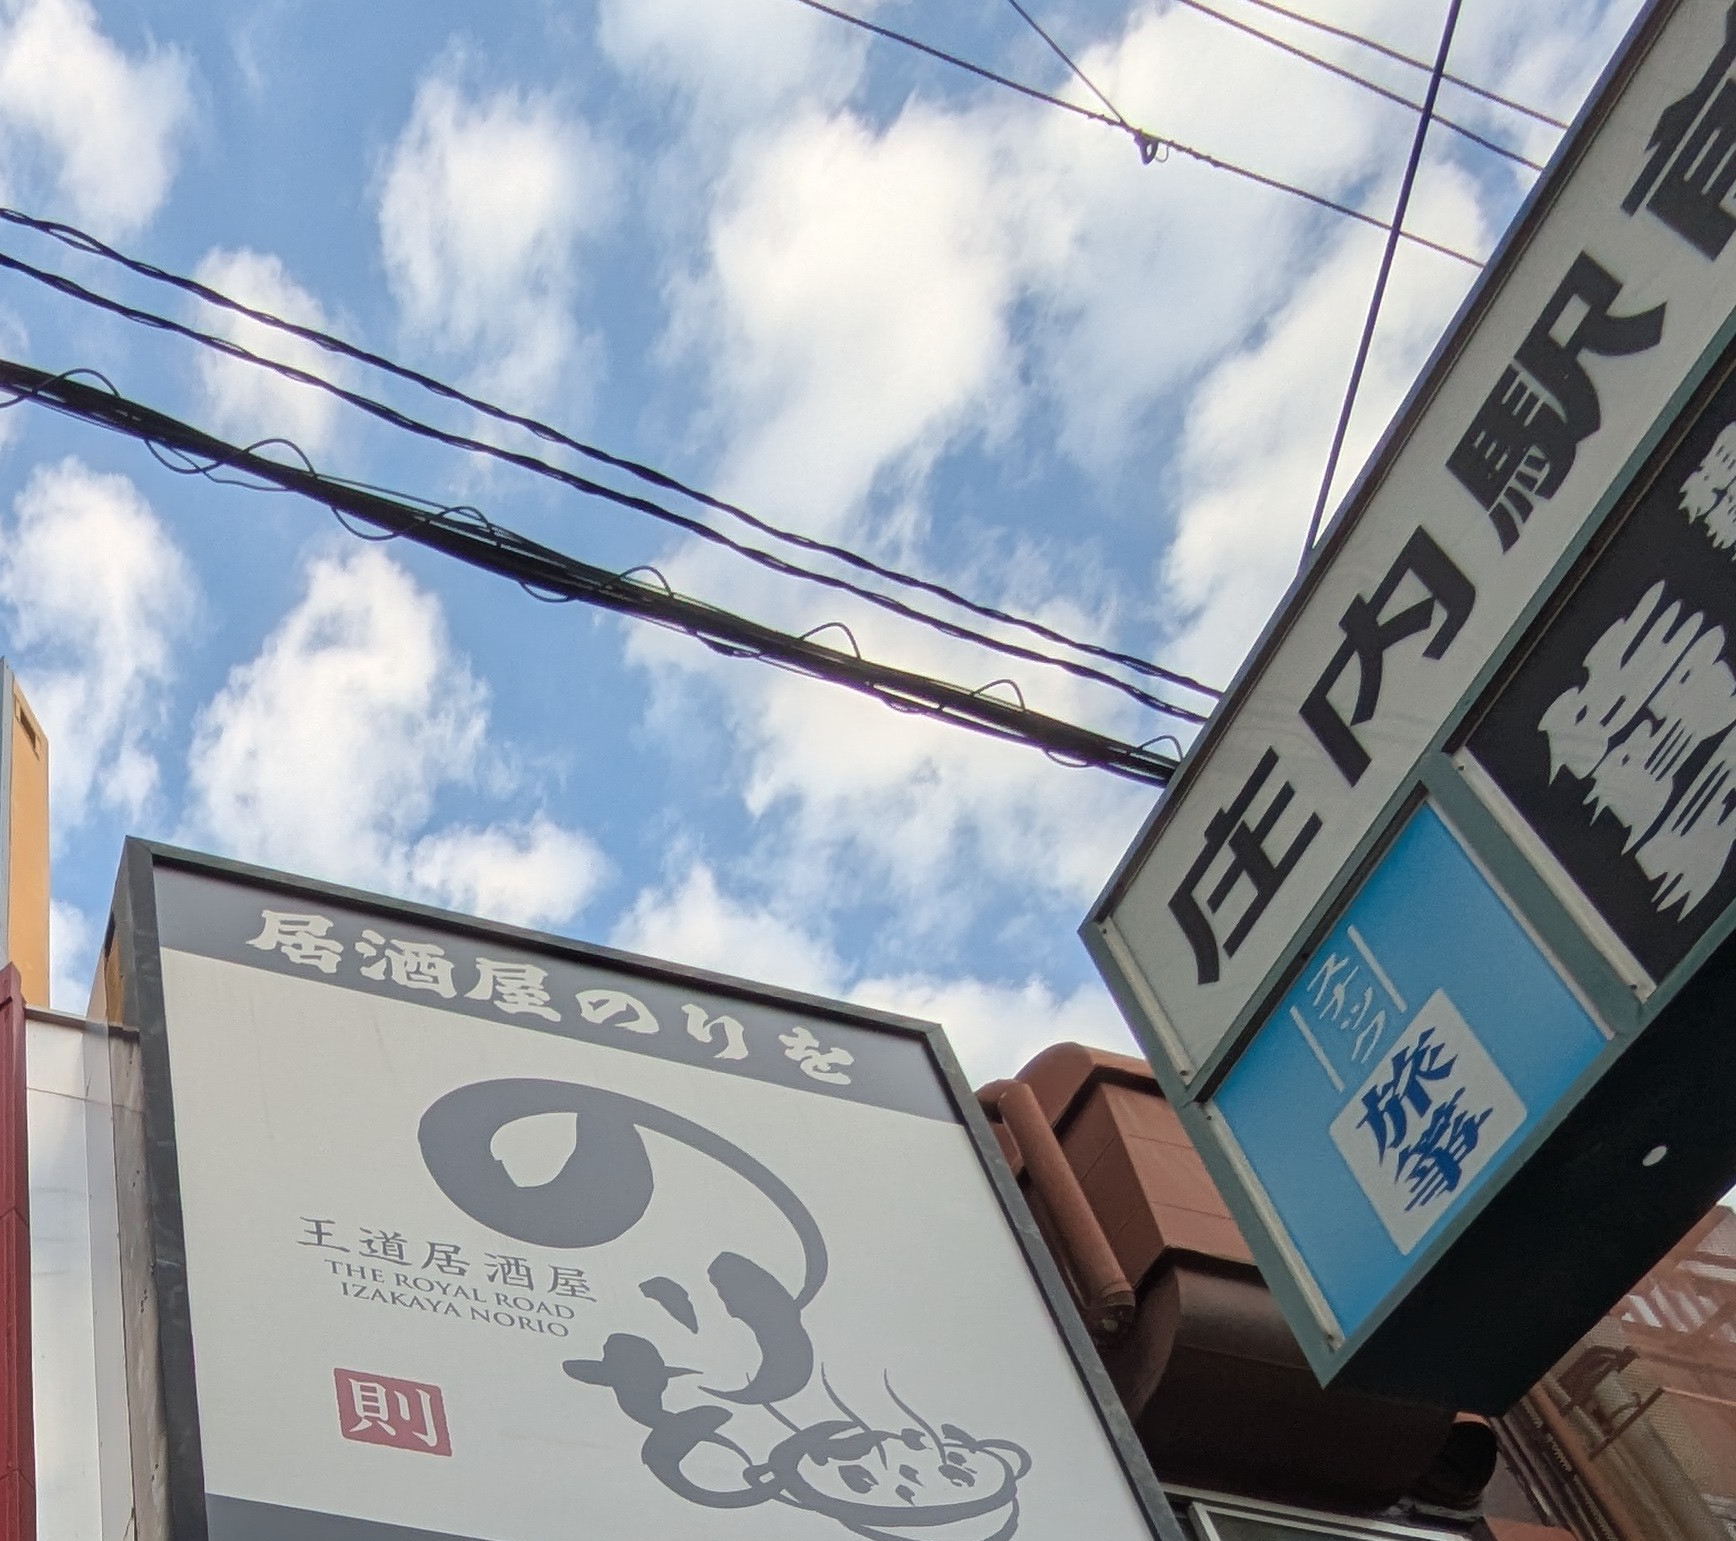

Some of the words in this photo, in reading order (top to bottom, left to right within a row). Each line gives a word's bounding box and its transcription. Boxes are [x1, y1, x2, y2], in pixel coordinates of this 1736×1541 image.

[248, 909, 855, 1086] 居酒屋のりを
[1307, 952, 1386, 1063] スナック
[295, 1216, 598, 1304] 王道居酒屋
[325, 1259, 384, 1286] THE
[393, 1272, 486, 1305] ROYAL
[494, 1292, 575, 1321] ROAD
[340, 1281, 460, 1319] IZAKAYA
[469, 1306, 569, 1338] NORIO
[348, 1380, 441, 1449] 則
